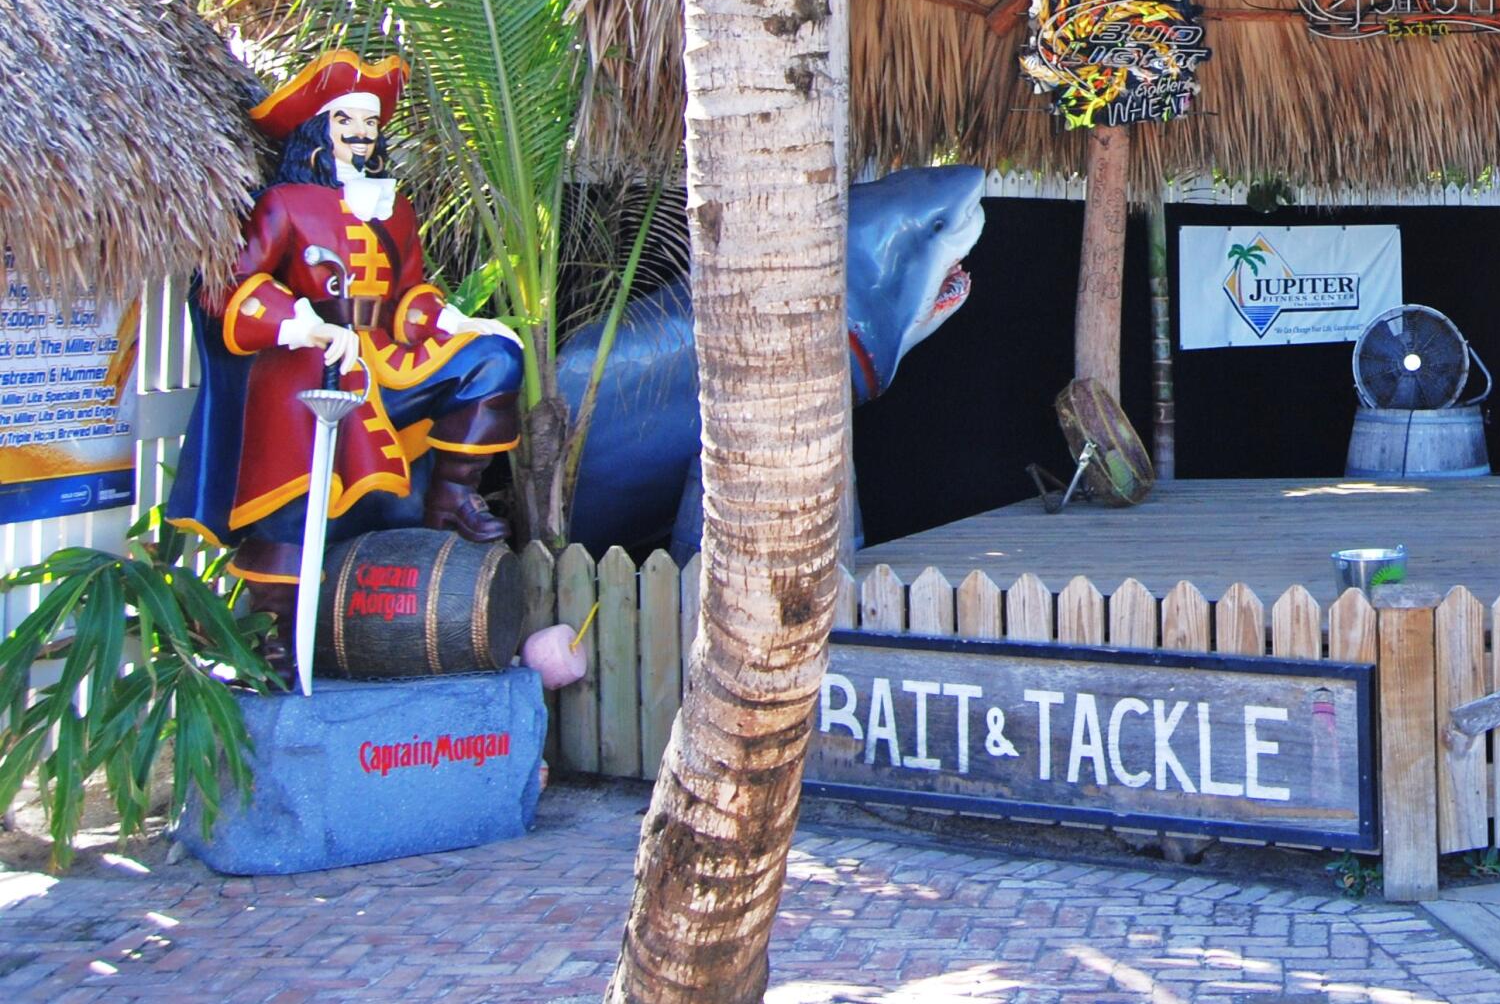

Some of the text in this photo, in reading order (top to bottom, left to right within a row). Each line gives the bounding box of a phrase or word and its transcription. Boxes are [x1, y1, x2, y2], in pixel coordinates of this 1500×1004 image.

[1089, 21, 1203, 45] BUD
[1387, 16, 1452, 38] Extra
[1058, 41, 1208, 68] LIGHT
[1107, 93, 1190, 127] WHEAT
[1249, 276, 1354, 302] JUPITER
[1263, 293, 1354, 303] FITNESS CENTER
[1, 312, 46, 331] 7:00pm
[16, 340, 36, 356] out
[41, 339, 62, 355] The
[65, 338, 95, 353] Miller
[97, 338, 118, 352] Lite
[0, 370, 46, 386] stream
[60, 367, 107, 382] Hummer
[27, 392, 43, 404] Lite
[45, 390, 80, 404] Specials
[94, 387, 115, 401] Night
[14, 412, 36, 424] Miller
[38, 411, 55, 422] Lite
[77, 408, 93, 419] and
[95, 406, 117, 421] Enjoy
[8, 432, 32, 444] Triple
[58, 427, 91, 440] Brewed
[92, 425, 114, 436] Miller
[115, 423, 130, 434] Lite
[356, 562, 420, 590] Captain
[347, 590, 418, 622] Morgan
[818, 673, 1291, 802] BAIT & TACKLE
[359, 730, 510, 777] Captain Morgan
